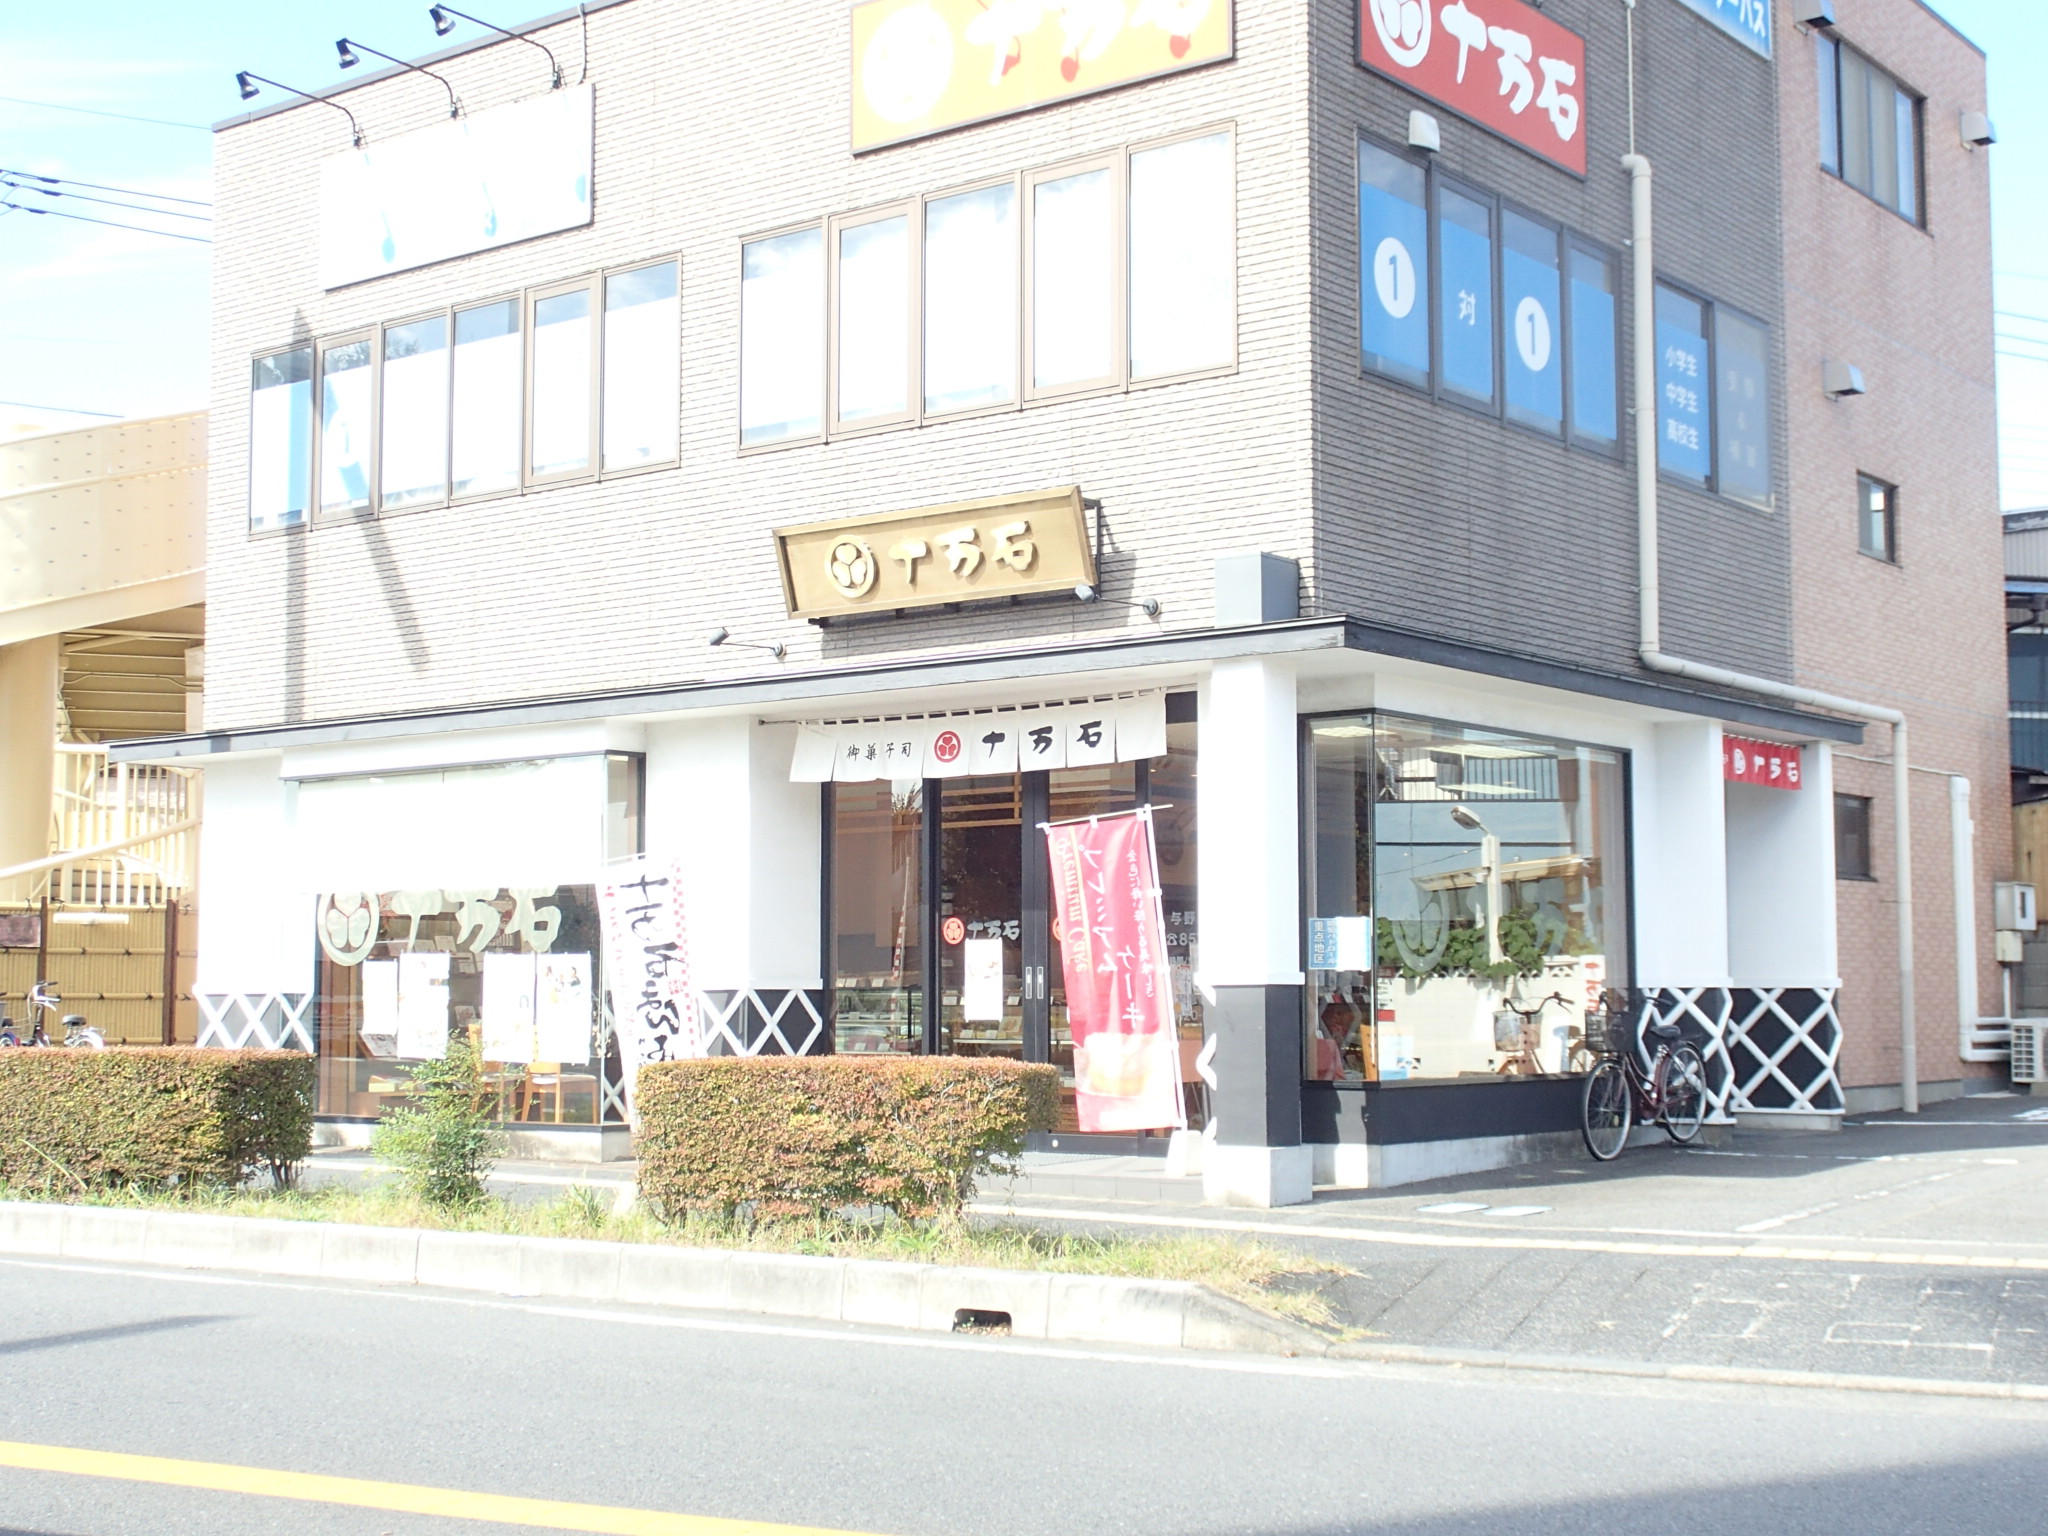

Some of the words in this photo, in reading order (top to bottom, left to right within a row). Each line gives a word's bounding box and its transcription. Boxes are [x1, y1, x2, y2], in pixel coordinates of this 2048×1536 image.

[1440, 0, 1579, 141] 十万石
[1458, 289, 1476, 327] 対
[1665, 345, 1698, 377] 小学生
[1665, 382, 1699, 414] 中学生
[1666, 418, 1699, 451] 高校生
[888, 520, 1038, 585] 十万石
[846, 741, 912, 762] 御菓子司
[982, 720, 1103, 759] 十万石
[1753, 754, 1799, 783] 十万石
[392, 888, 562, 953] 十万石
[967, 920, 1020, 941] 十万石
[1313, 921, 1325, 964] 重点地区
